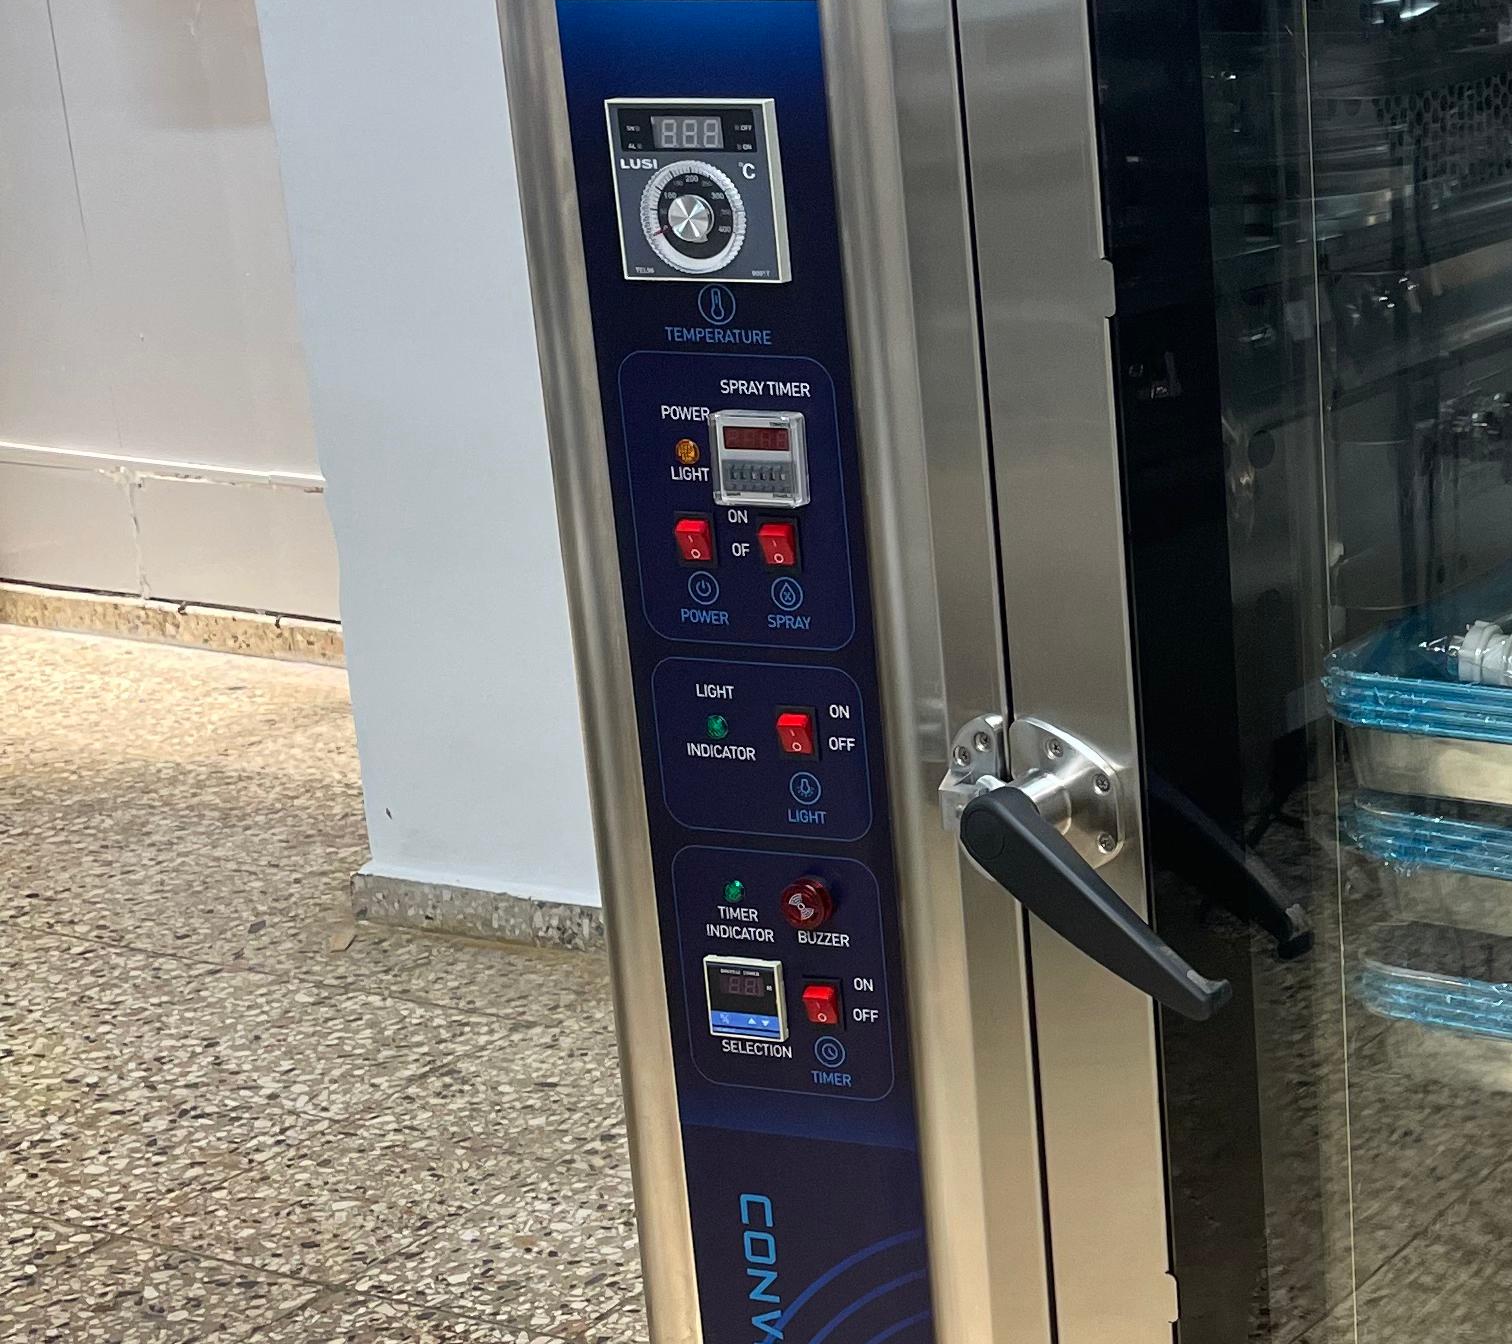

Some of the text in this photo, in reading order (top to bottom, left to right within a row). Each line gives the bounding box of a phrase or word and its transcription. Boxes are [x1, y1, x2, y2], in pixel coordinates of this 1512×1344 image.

[619, 158, 658, 170] LUSI
[664, 326, 772, 345] TEMPERATURE
[720, 379, 811, 398] SPRAY TIMER
[661, 405, 711, 421] POWER
[670, 466, 710, 482] LIGHT
[727, 509, 749, 524] ON
[680, 608, 730, 625] POWER
[767, 614, 811, 630] SPRAY
[695, 683, 735, 700] LIGHT
[829, 704, 850, 719] ON
[686, 742, 757, 761] INDICATOR
[828, 736, 856, 752] OFF
[787, 808, 827, 825] LIGHT
[717, 905, 759, 923] TIMER
[706, 923, 775, 943] INDICATOR
[797, 930, 850, 948] BUZZER
[853, 977, 874, 992] ON
[853, 1008, 879, 1023] OFF
[721, 1039, 793, 1059] SELECTION
[811, 1070, 852, 1087] TIMER
